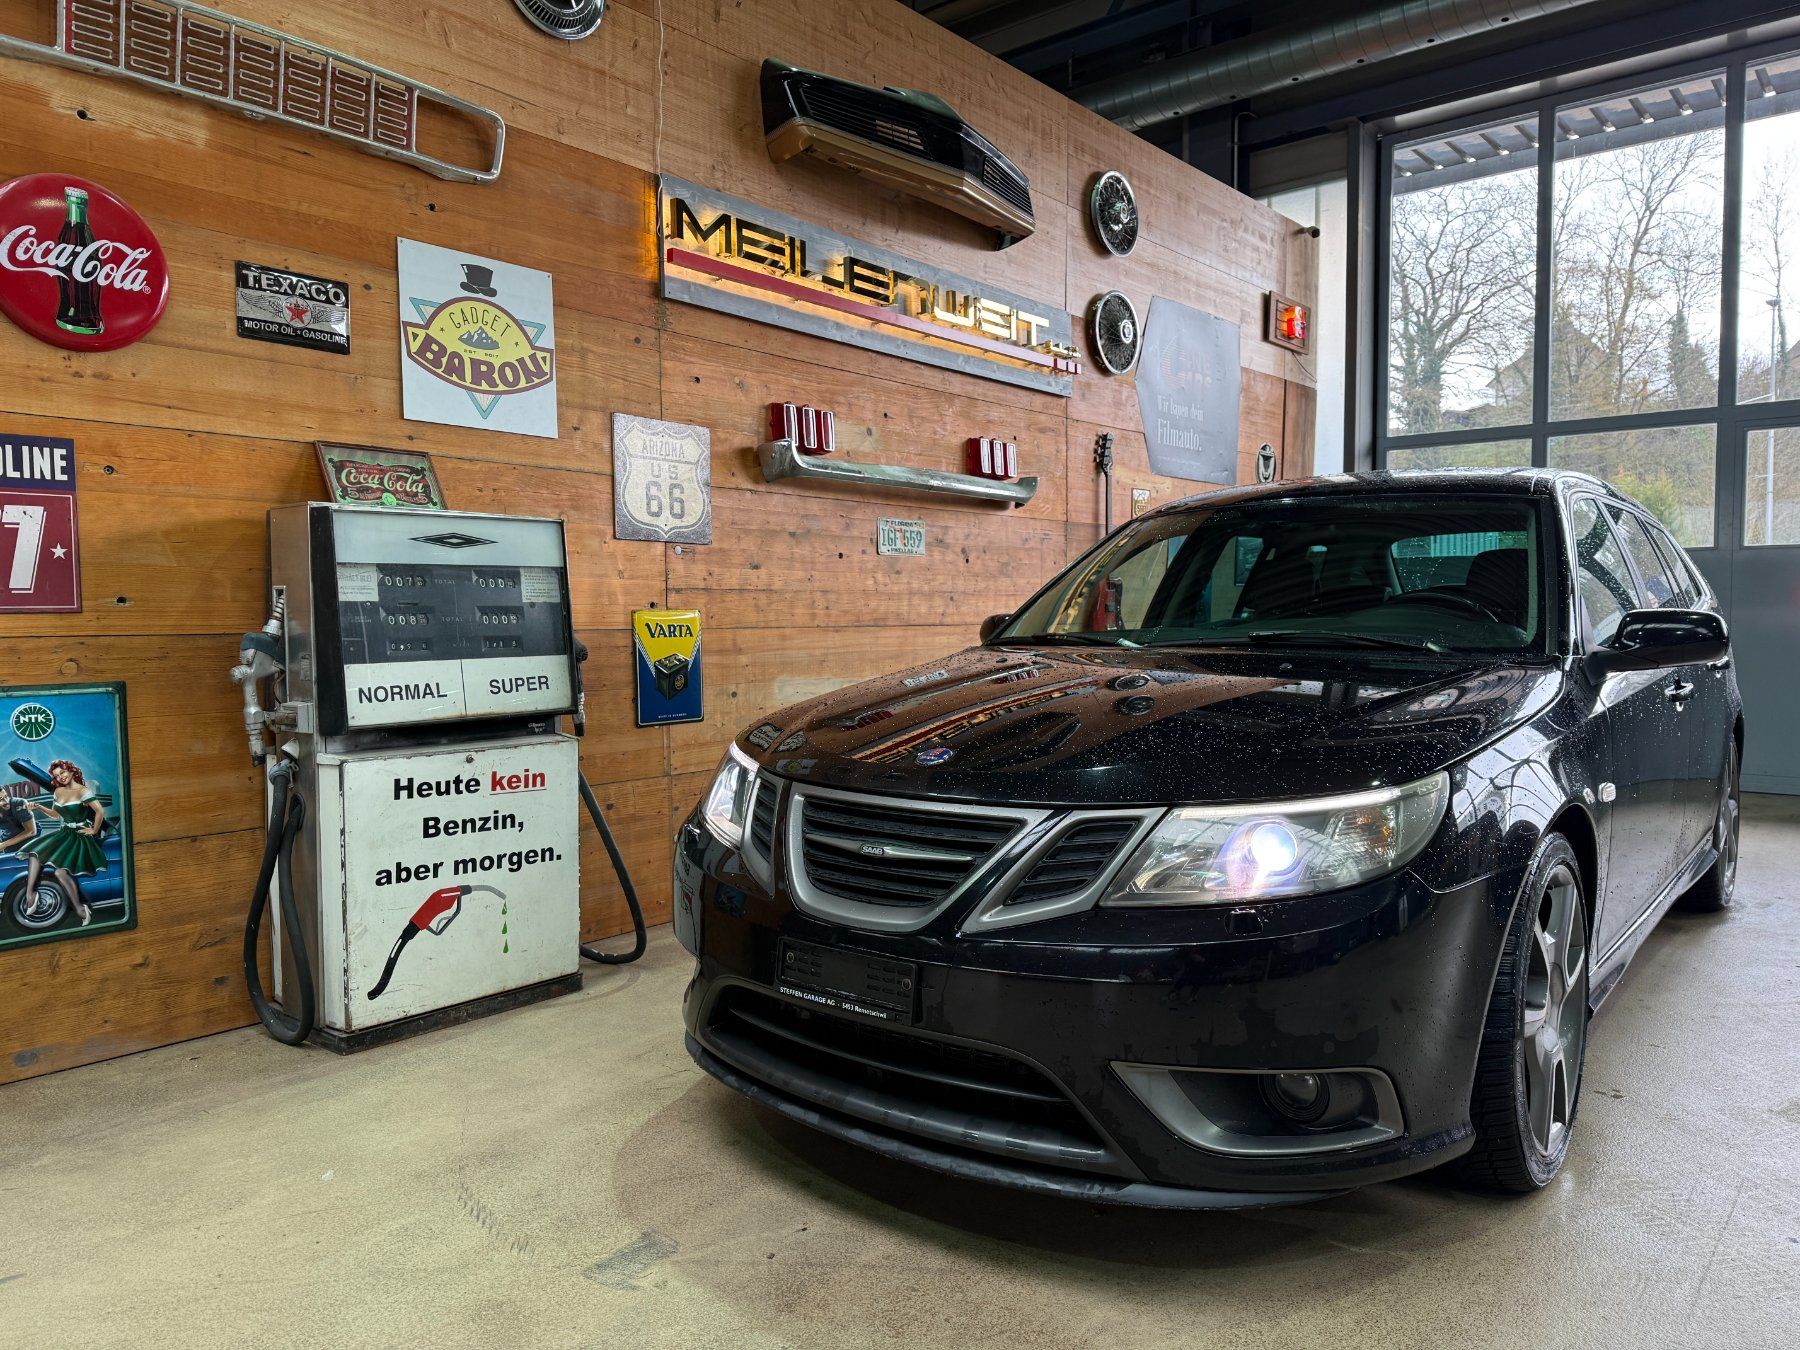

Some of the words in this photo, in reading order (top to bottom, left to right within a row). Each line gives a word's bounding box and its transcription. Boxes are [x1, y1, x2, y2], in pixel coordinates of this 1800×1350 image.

[0, 225, 152, 292] Coca-Cola
[242, 269, 347, 307] TEXACO
[243, 319, 279, 334] MOTOR
[281, 325, 296, 336] OIL
[302, 329, 348, 347] GASOLINE
[449, 306, 511, 338] GADGET
[411, 331, 549, 389] BARON
[0, 444, 69, 481] LINE
[641, 439, 685, 459] ARIZONA
[341, 467, 424, 493] Coca-Cola
[645, 480, 686, 520] 66
[644, 622, 694, 639] VARTA
[357, 682, 448, 704] NORMAL
[488, 675, 551, 695] SUPER
[20, 713, 46, 724] NTK
[393, 774, 481, 801] Heute
[490, 768, 546, 792] kein
[422, 809, 524, 839] Benzin,
[375, 862, 444, 887] aber
[453, 846, 562, 873] morgen.
[780, 986, 803, 998] STEFFEN
[803, 993, 826, 1004] GARAGE
